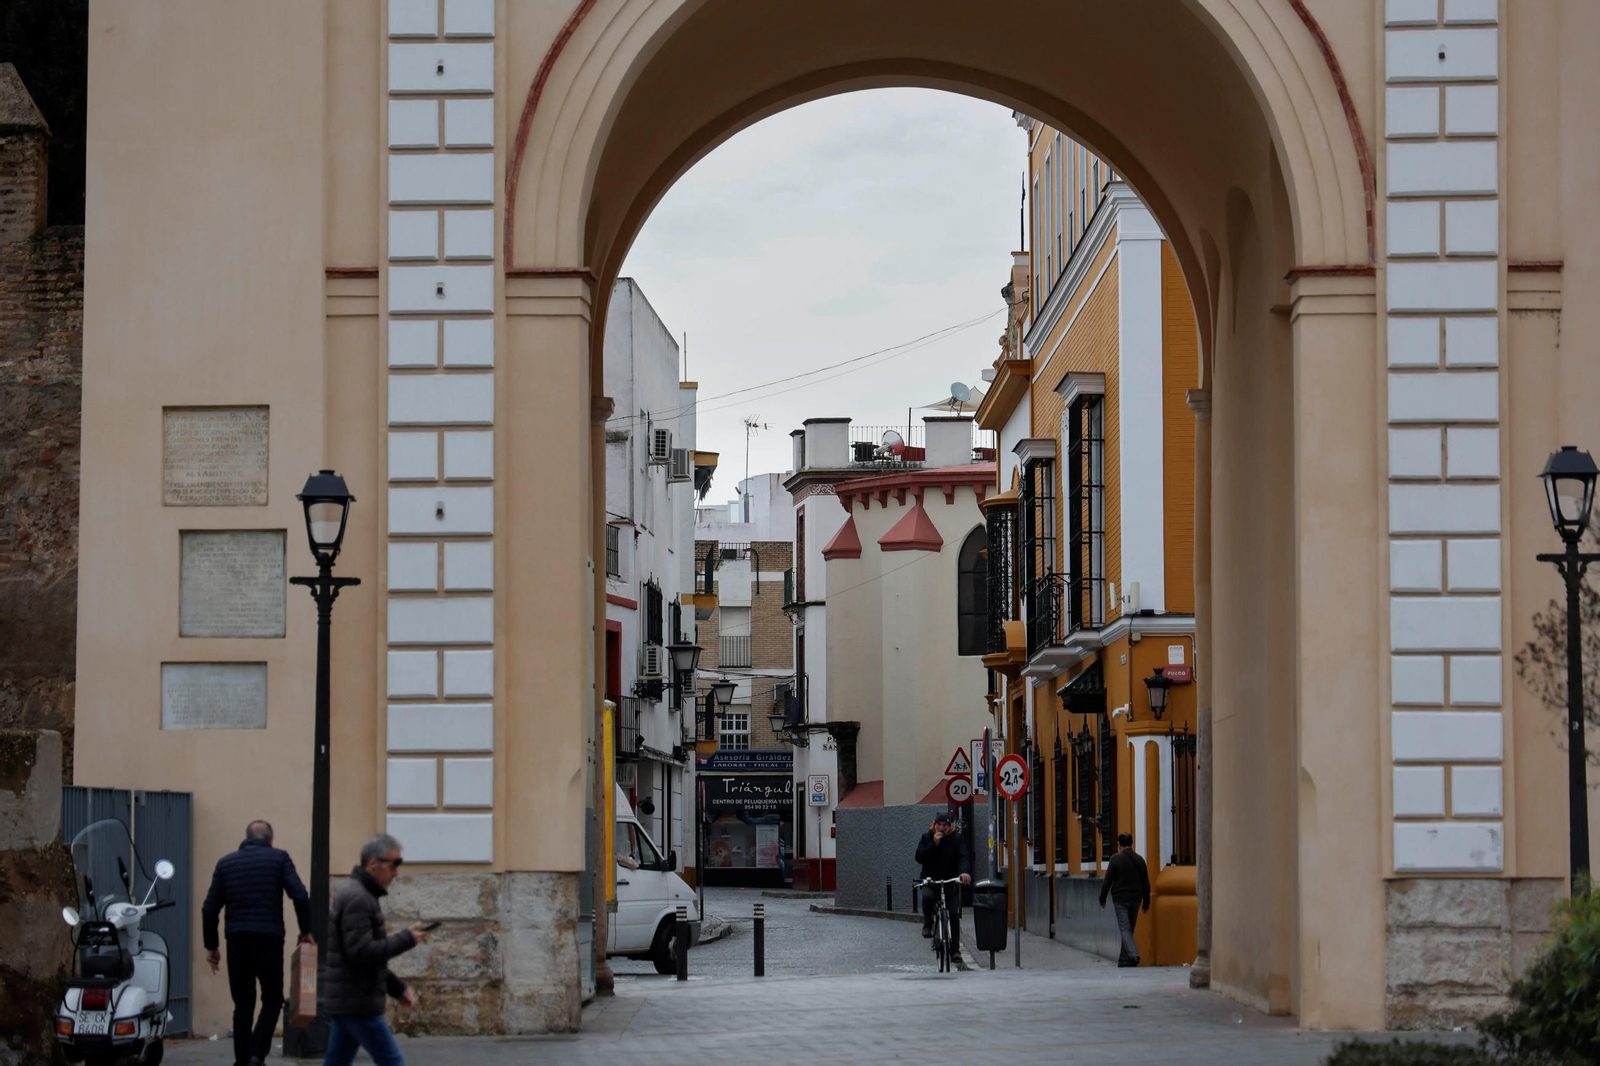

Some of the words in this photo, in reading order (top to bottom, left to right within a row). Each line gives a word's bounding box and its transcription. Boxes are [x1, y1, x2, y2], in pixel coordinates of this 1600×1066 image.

[756, 753, 791, 761] Giráldez
[953, 785, 967, 795] 20
[79, 1012, 89, 1022] SE
[95, 1012, 106, 1022] CK
[78, 1024, 104, 1034] 6408
